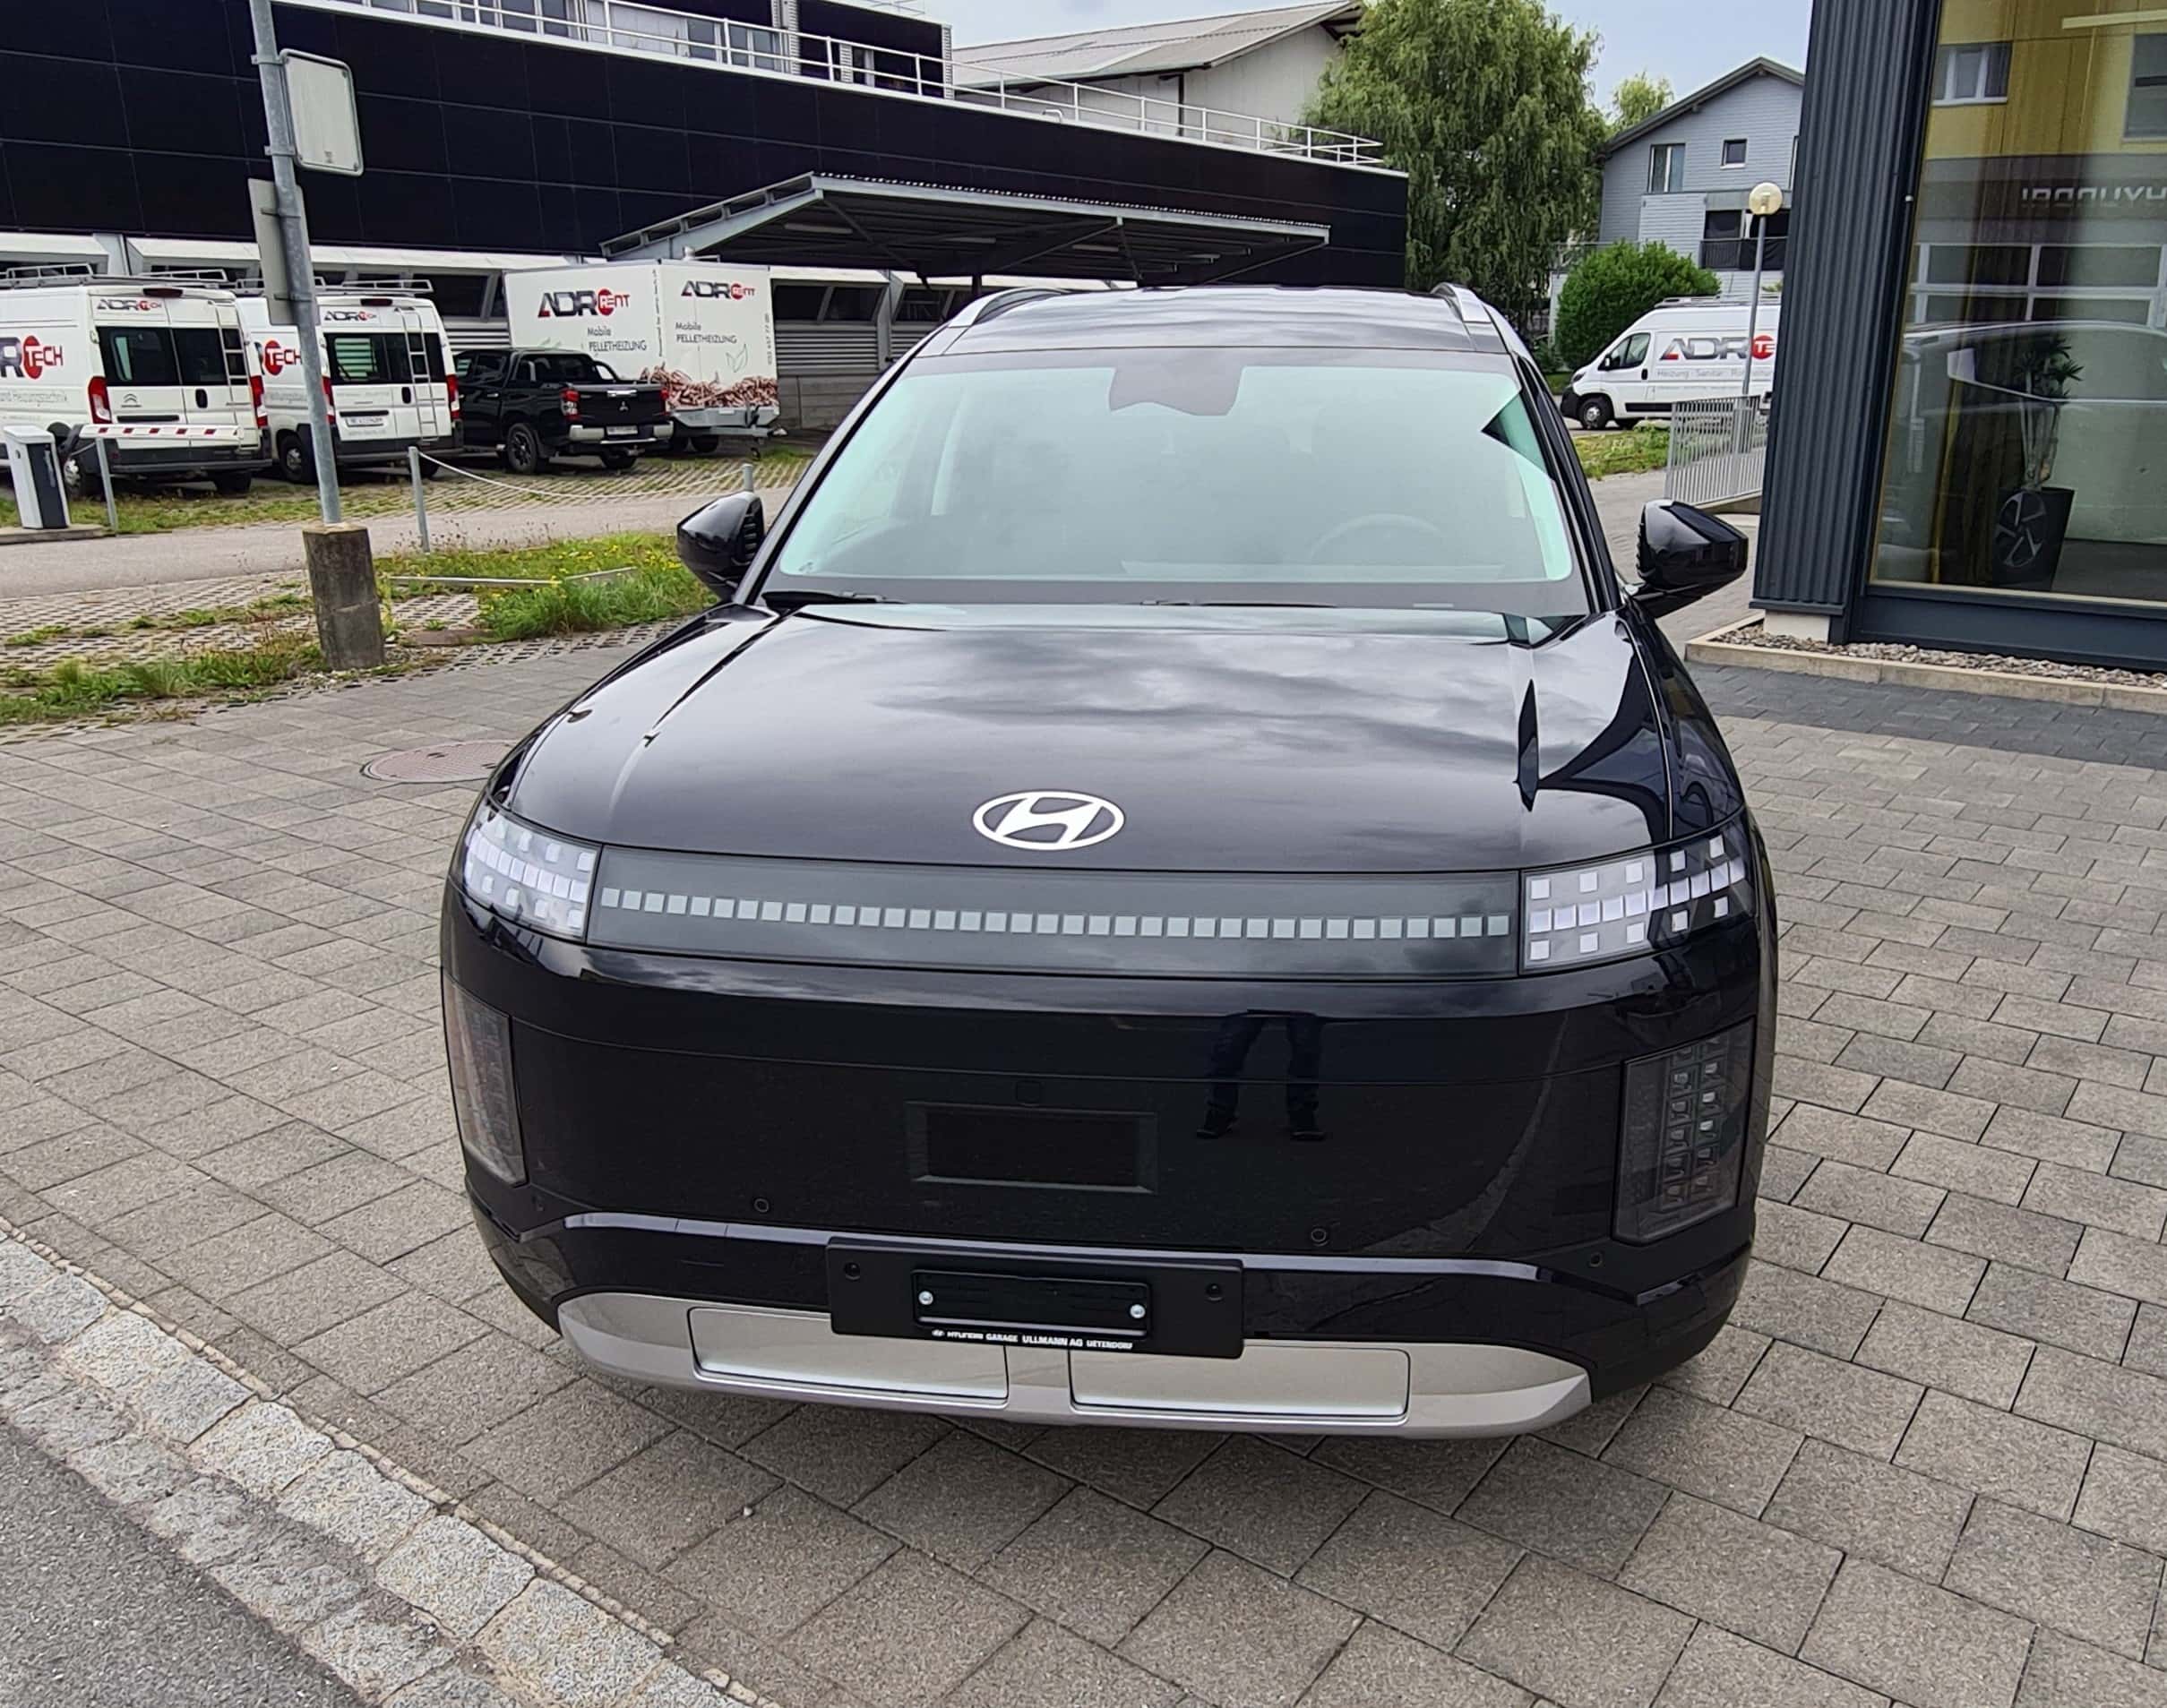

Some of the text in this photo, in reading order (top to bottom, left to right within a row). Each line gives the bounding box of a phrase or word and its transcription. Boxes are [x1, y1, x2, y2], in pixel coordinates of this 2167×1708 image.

[587, 325, 612, 337] Mobile
[675, 322, 702, 331] Mobile
[675, 333, 738, 344] PELLETHEIZUNG
[588, 339, 648, 352] PELLETHEIZUNG
[985, 1333, 1019, 1343] GARAGE
[1022, 1335, 1068, 1346] ULLMANN
[1069, 1338, 1083, 1347] AG
